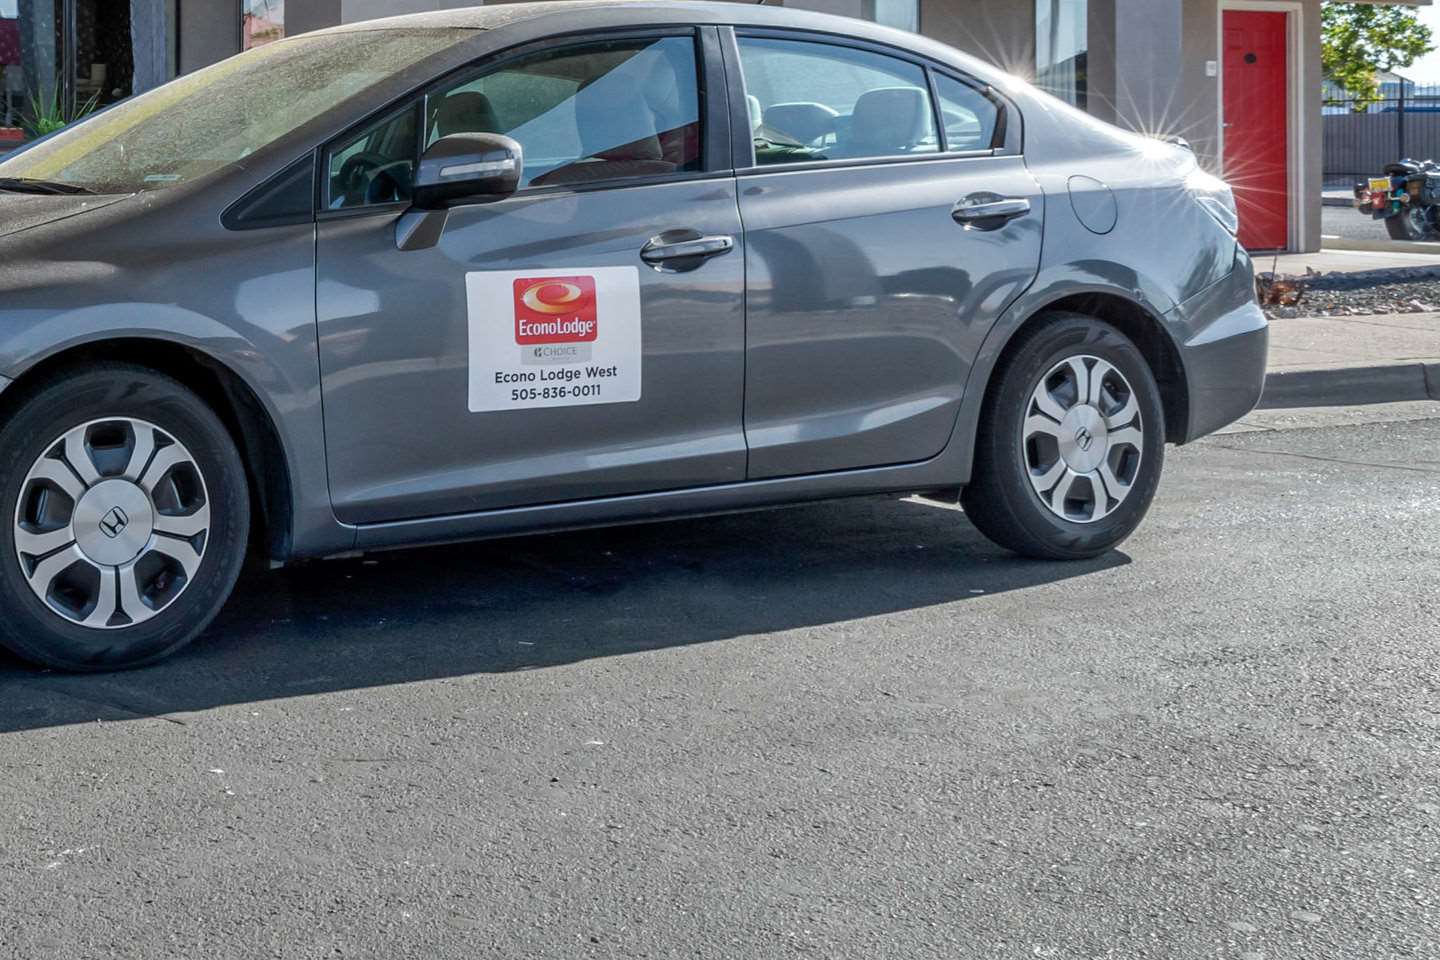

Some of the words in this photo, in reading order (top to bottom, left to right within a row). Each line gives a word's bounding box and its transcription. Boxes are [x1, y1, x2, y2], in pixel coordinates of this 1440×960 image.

[519, 317, 593, 336] EconoLodge
[495, 371, 536, 384] Econo
[540, 368, 581, 382] Lodge
[585, 365, 618, 378] West
[511, 384, 601, 400] 505-836-0011
